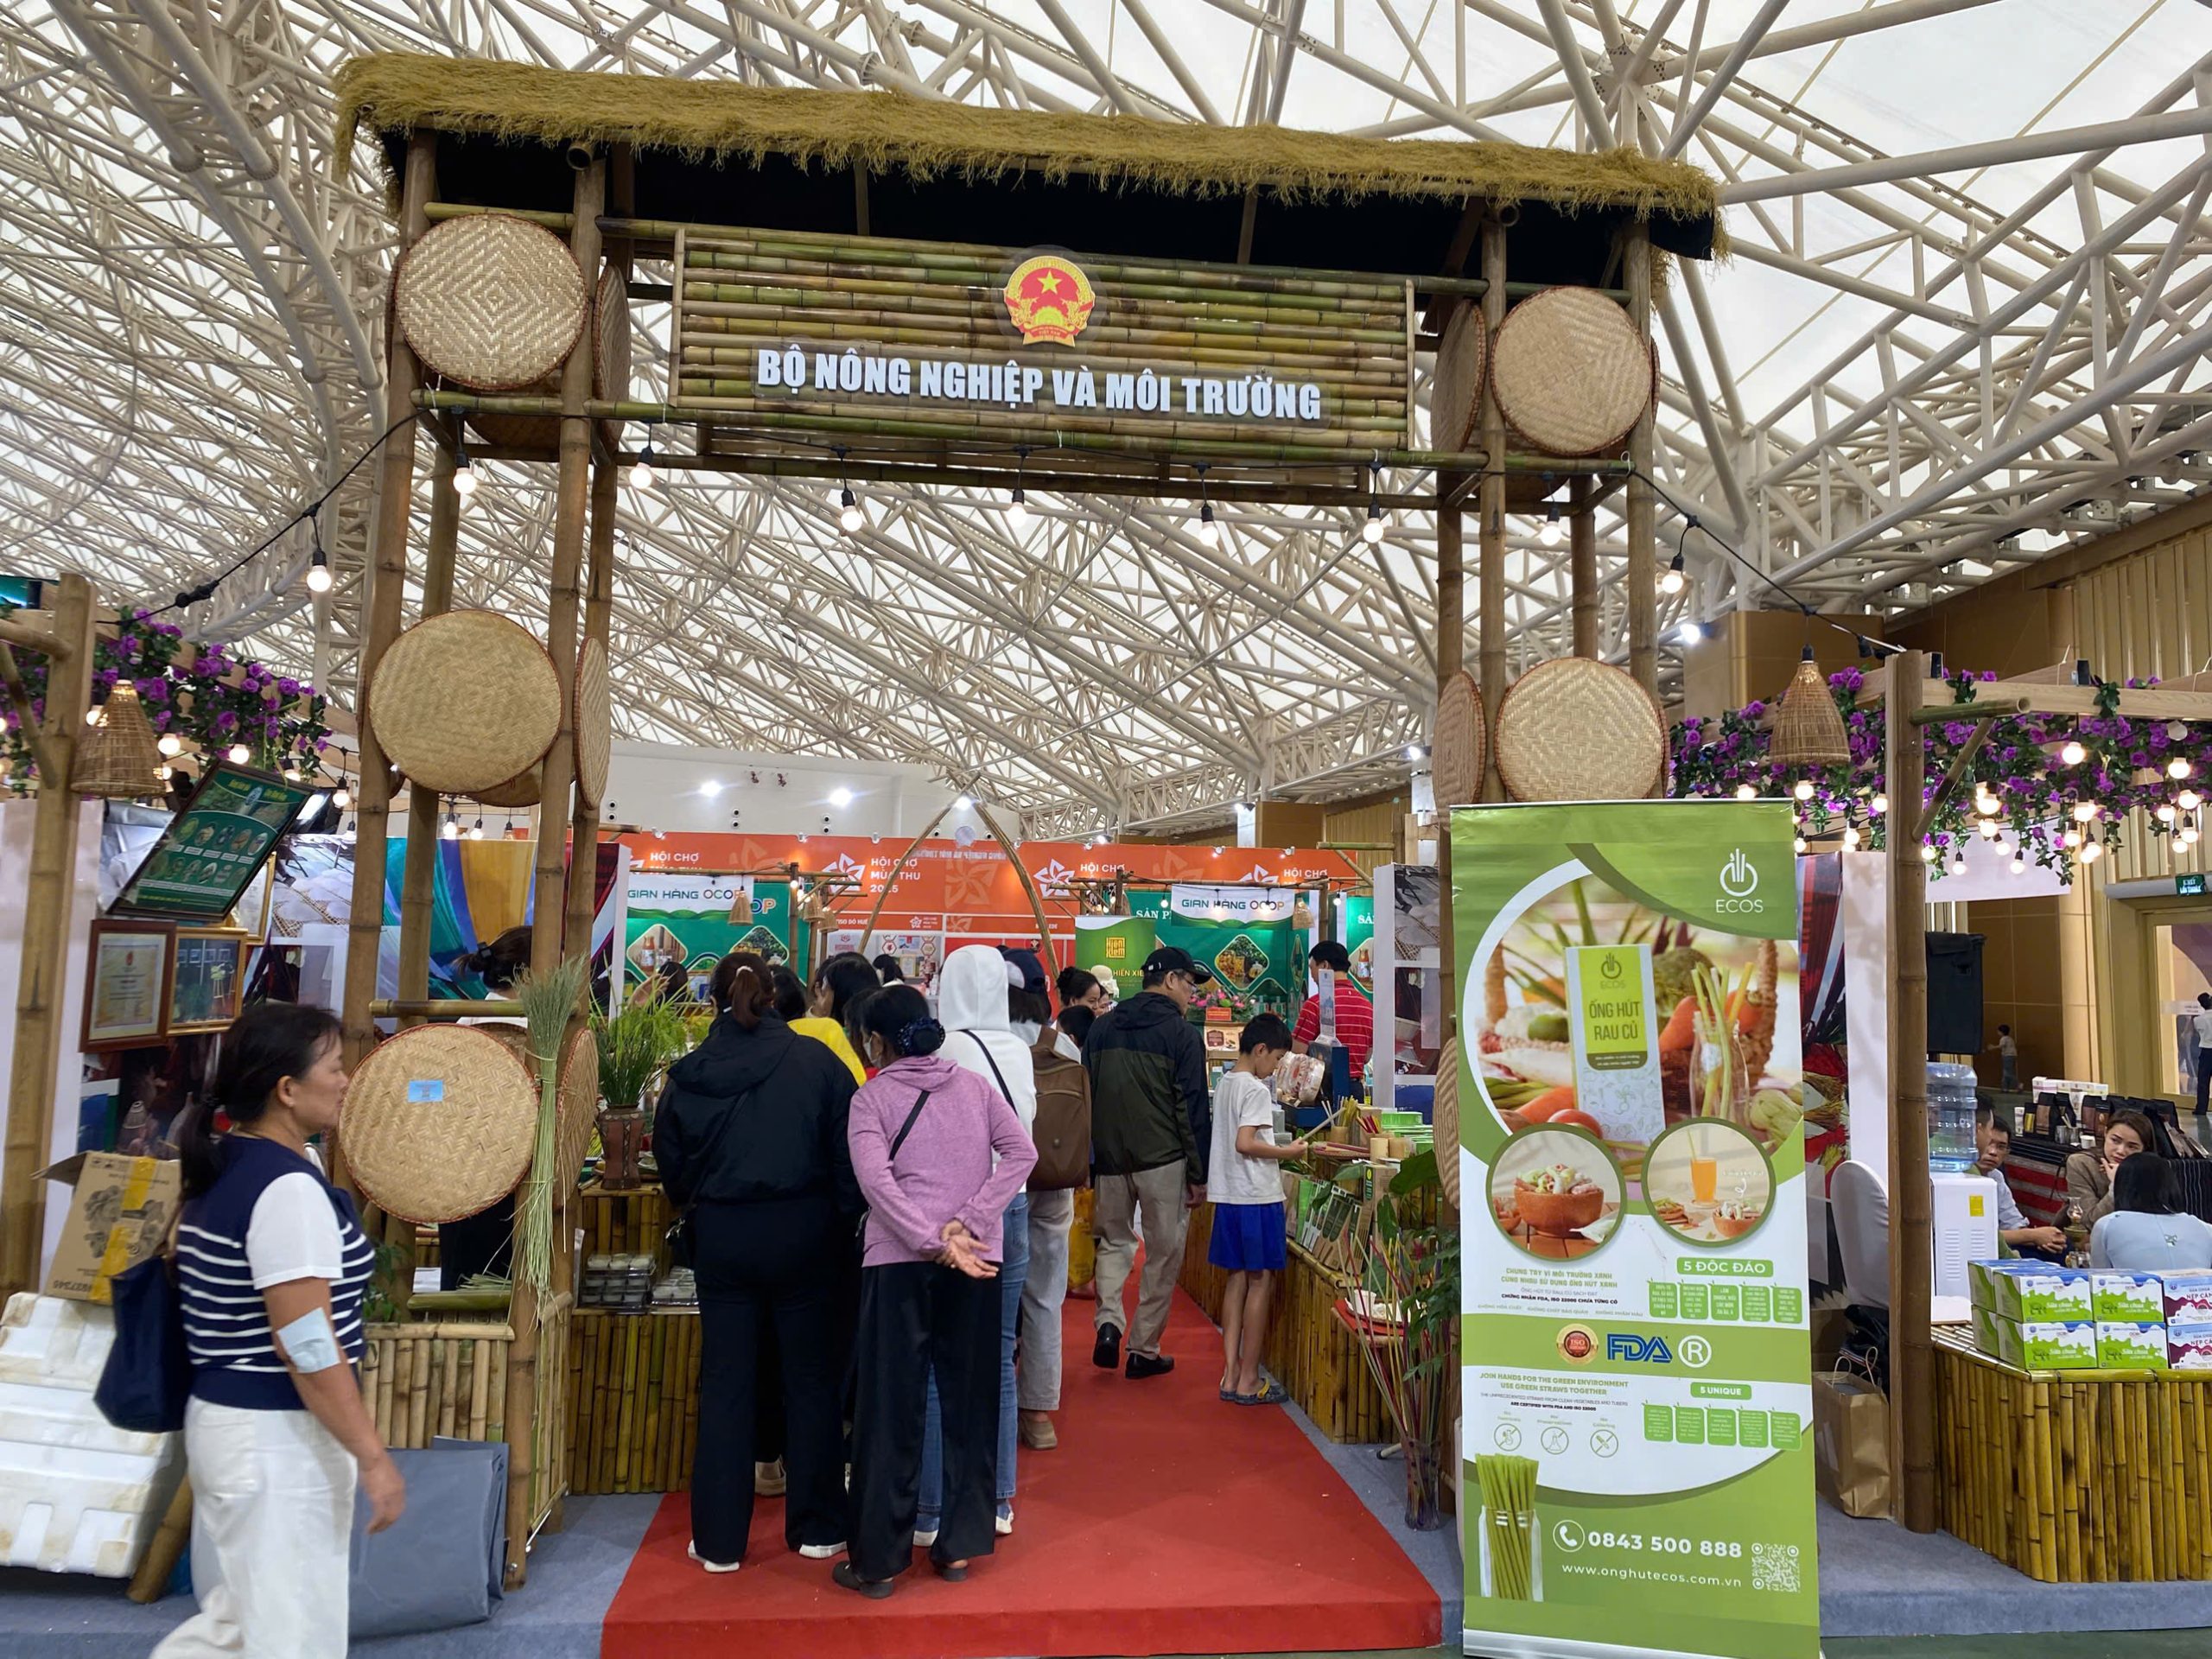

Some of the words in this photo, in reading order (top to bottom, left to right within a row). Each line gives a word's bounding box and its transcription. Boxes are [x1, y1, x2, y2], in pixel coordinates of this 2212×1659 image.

[758, 345, 805, 396] BỘ
[816, 346, 911, 396] NÔNG
[920, 359, 1043, 410] NGHIỆP
[1053, 365, 1096, 410] VÀ
[1106, 368, 1172, 413] MÔI
[1182, 372, 1321, 421] TRƯỜNG
[650, 852, 671, 863] HỘI
[674, 852, 699, 864] CHỢ
[871, 856, 890, 868] HỘI
[871, 869, 893, 880] MÙ
[627, 890, 658, 899] GIAN
[662, 888, 698, 899] HÀNG
[750, 899, 776, 914] OP
[1213, 899, 1246, 910] HÀNG
[1716, 899, 1764, 912] ECOS
[1136, 907, 1159, 919] SẢN
[1357, 912, 1374, 924] SẢ
[1590, 999, 1613, 1019] ỐNG
[1617, 999, 1640, 1017] HÚT
[1594, 1025, 1619, 1040] RAU
[1621, 1020, 1638, 1039] CỦ
[1683, 1262, 1692, 1272] 5
[1695, 1260, 1728, 1274] ĐỘC
[1732, 1260, 1766, 1274] ĐÁO
[1607, 1334, 1673, 1363] FDA
[1578, 1379, 1629, 1388] ENVIRONMENT
[1707, 1386, 1742, 1396] UNIQUE
[1588, 1531, 1643, 1550] 0843
[1650, 1536, 1692, 1554] 500
[1700, 1540, 1742, 1559] 888
[1561, 1564, 1742, 1587] www.onghutecos.com.vn
